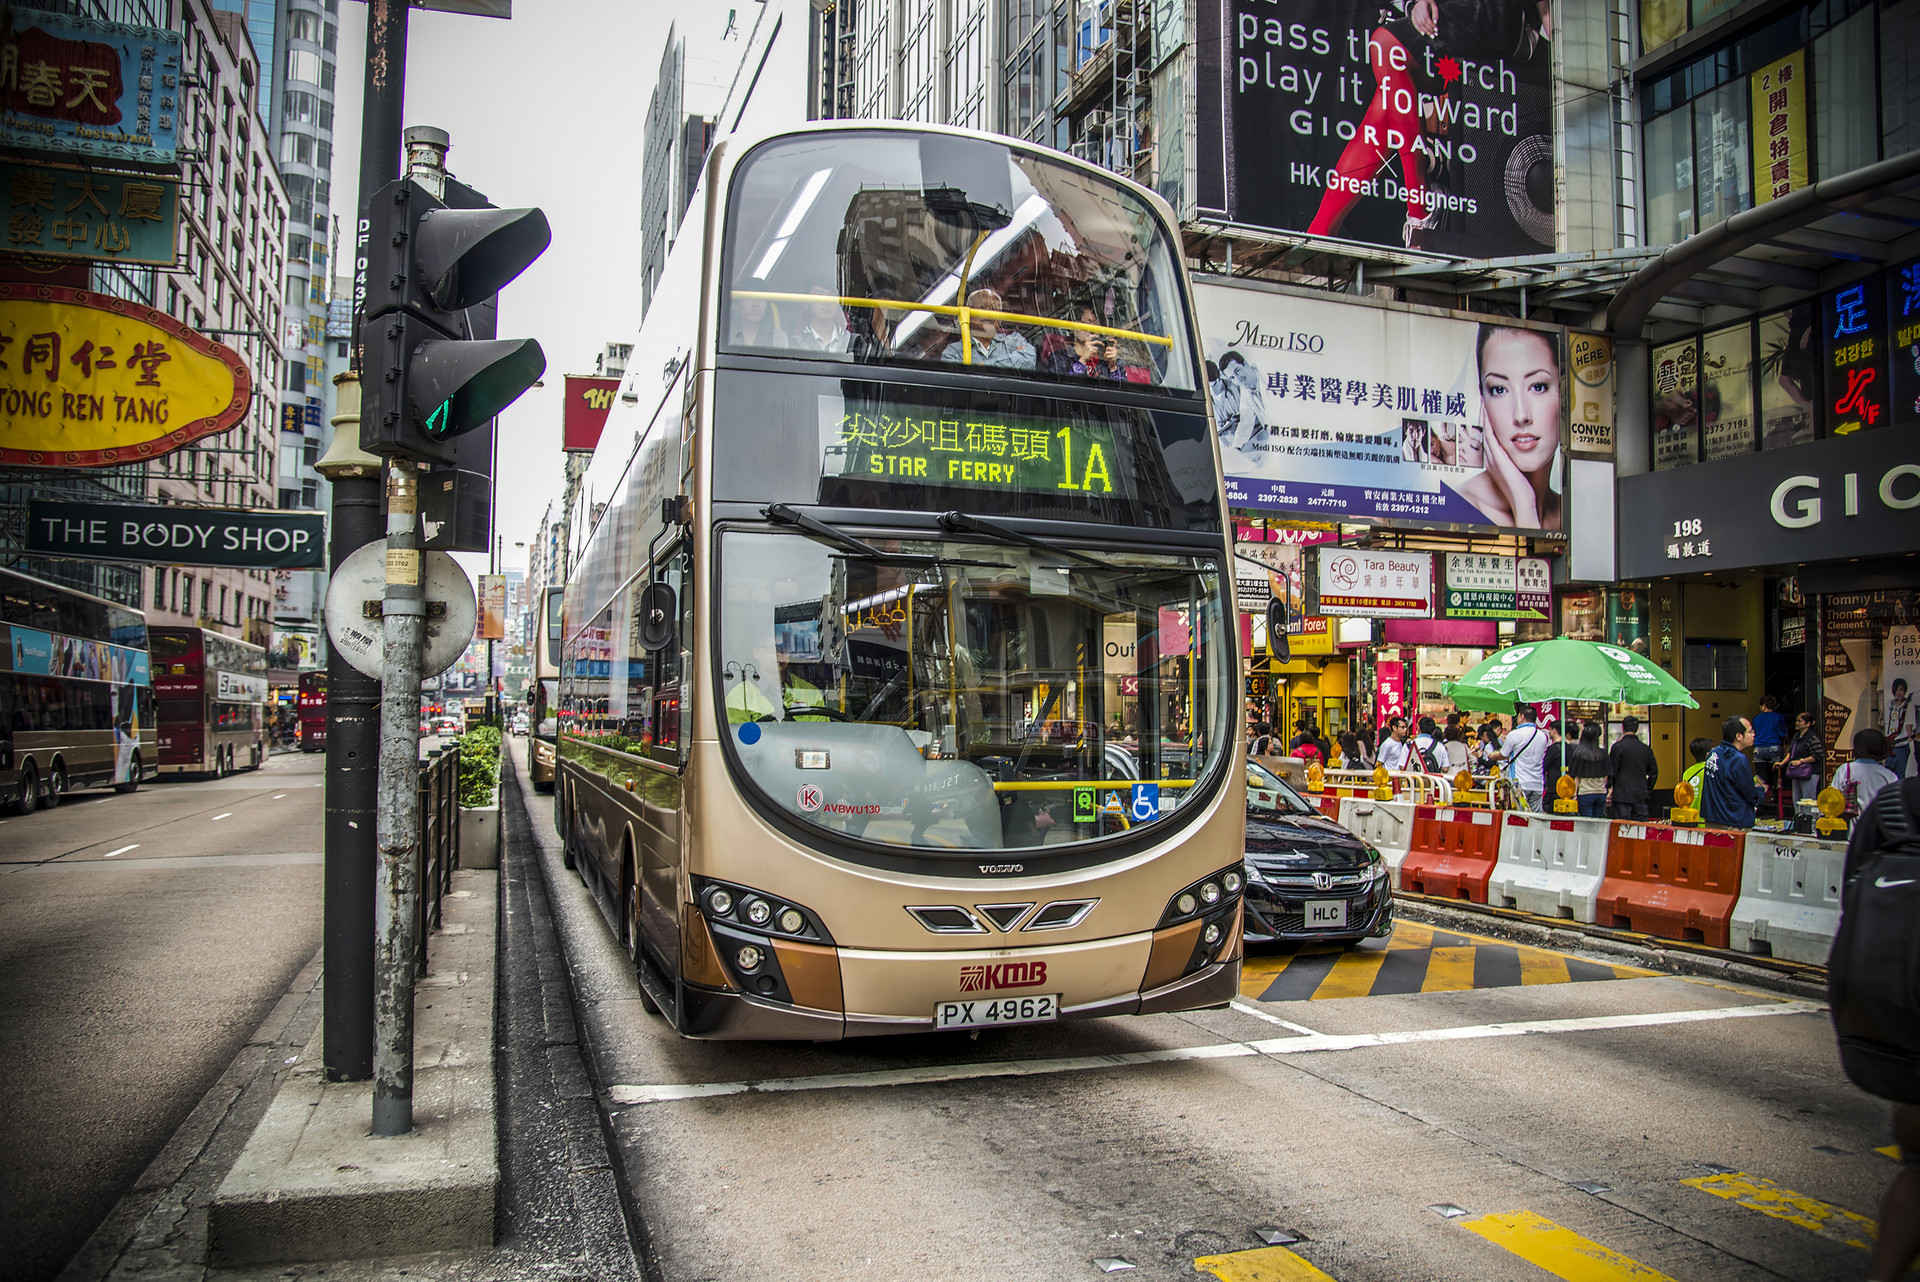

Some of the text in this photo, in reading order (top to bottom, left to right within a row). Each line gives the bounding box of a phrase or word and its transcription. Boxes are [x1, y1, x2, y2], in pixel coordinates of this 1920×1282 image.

[1239, 12, 1516, 95] pass the trch
[1239, 51, 1517, 137] play it forward
[6, 116, 153, 147] Peking Restaurant
[1289, 109, 1477, 164] GIORDANO
[9, 168, 165, 222] 業大廈
[1290, 162, 1477, 214] HK Great Designers
[7, 211, 131, 251] 發中心
[1833, 284, 1869, 339] 足
[1289, 332, 1325, 353] ISO
[1575, 341, 1589, 354] AD
[1576, 348, 1604, 367] HERE
[1835, 338, 1874, 367] 건강한
[1267, 371, 1467, 418] 專業醫學美肌權威
[62, 391, 104, 421] REN
[114, 396, 169, 425] TANG
[1571, 423, 1611, 437] CONVEY
[1705, 418, 1748, 435] 2375 7198
[835, 412, 1050, 461] 尖沙咀碼頭
[1579, 435, 1594, 443] 2739
[1252, 443, 1270, 452] Medi
[1272, 445, 1285, 453] ISO
[871, 453, 1015, 483] STAR FERRY
[1056, 426, 1112, 492] 1A
[1271, 483, 1286, 494] 中環
[1320, 487, 1335, 498] 元朗
[1770, 464, 1920, 529] GIO
[1258, 493, 1298, 505] 2397-2828
[1307, 497, 1347, 508] 2477-7710
[1375, 502, 1429, 514] 佐敦 2397-1212
[41, 518, 312, 553] THE BODY SHOP.
[1673, 518, 1702, 538] 198
[1666, 539, 1712, 560] 彌敦道
[1364, 559, 1420, 574] Tara Beauty
[1523, 578, 1548, 588] 教育坊
[1825, 593, 1871, 607] Tommy
[1874, 591, 1885, 603] Li
[1825, 607, 1868, 620] Thomas
[1303, 617, 1327, 631] Forex
[1827, 620, 1864, 630] Clement
[1105, 641, 1136, 658] Out
[1893, 634, 1920, 647] pass
[1381, 682, 1399, 705] 莎莎
[1828, 703, 1844, 711] Chau
[823, 803, 881, 815] AVBWU130
[978, 864, 1024, 874] VOLVO
[1313, 907, 1338, 921] HLC
[984, 961, 1048, 991] KMB
[943, 997, 1052, 1025] PX 4962
